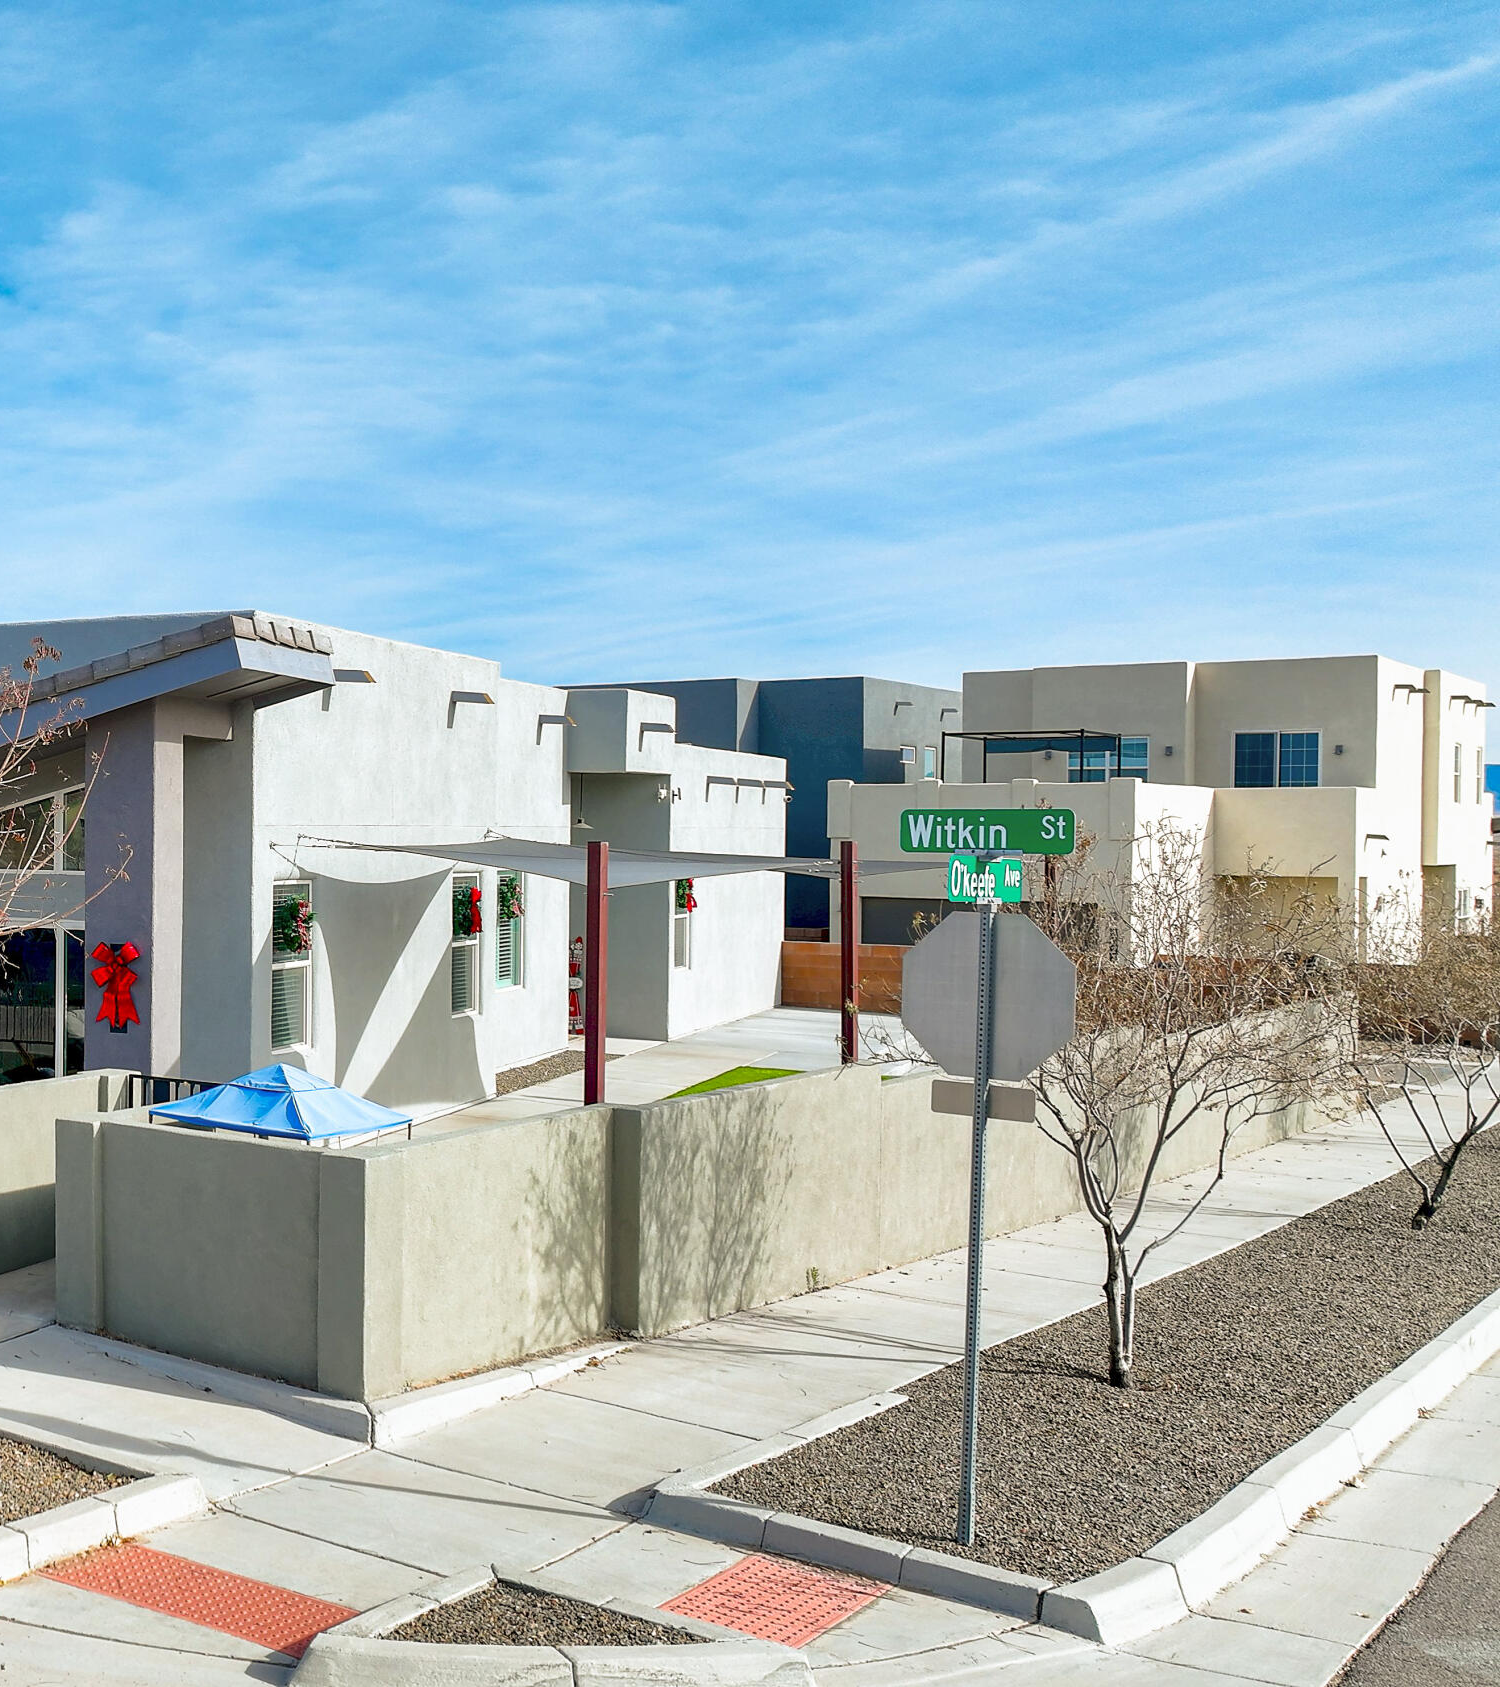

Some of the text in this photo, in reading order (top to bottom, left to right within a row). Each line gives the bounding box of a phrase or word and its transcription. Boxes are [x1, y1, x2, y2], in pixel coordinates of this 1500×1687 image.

[908, 814, 1067, 849] Witkin St
[1004, 863, 1021, 888] Ave
